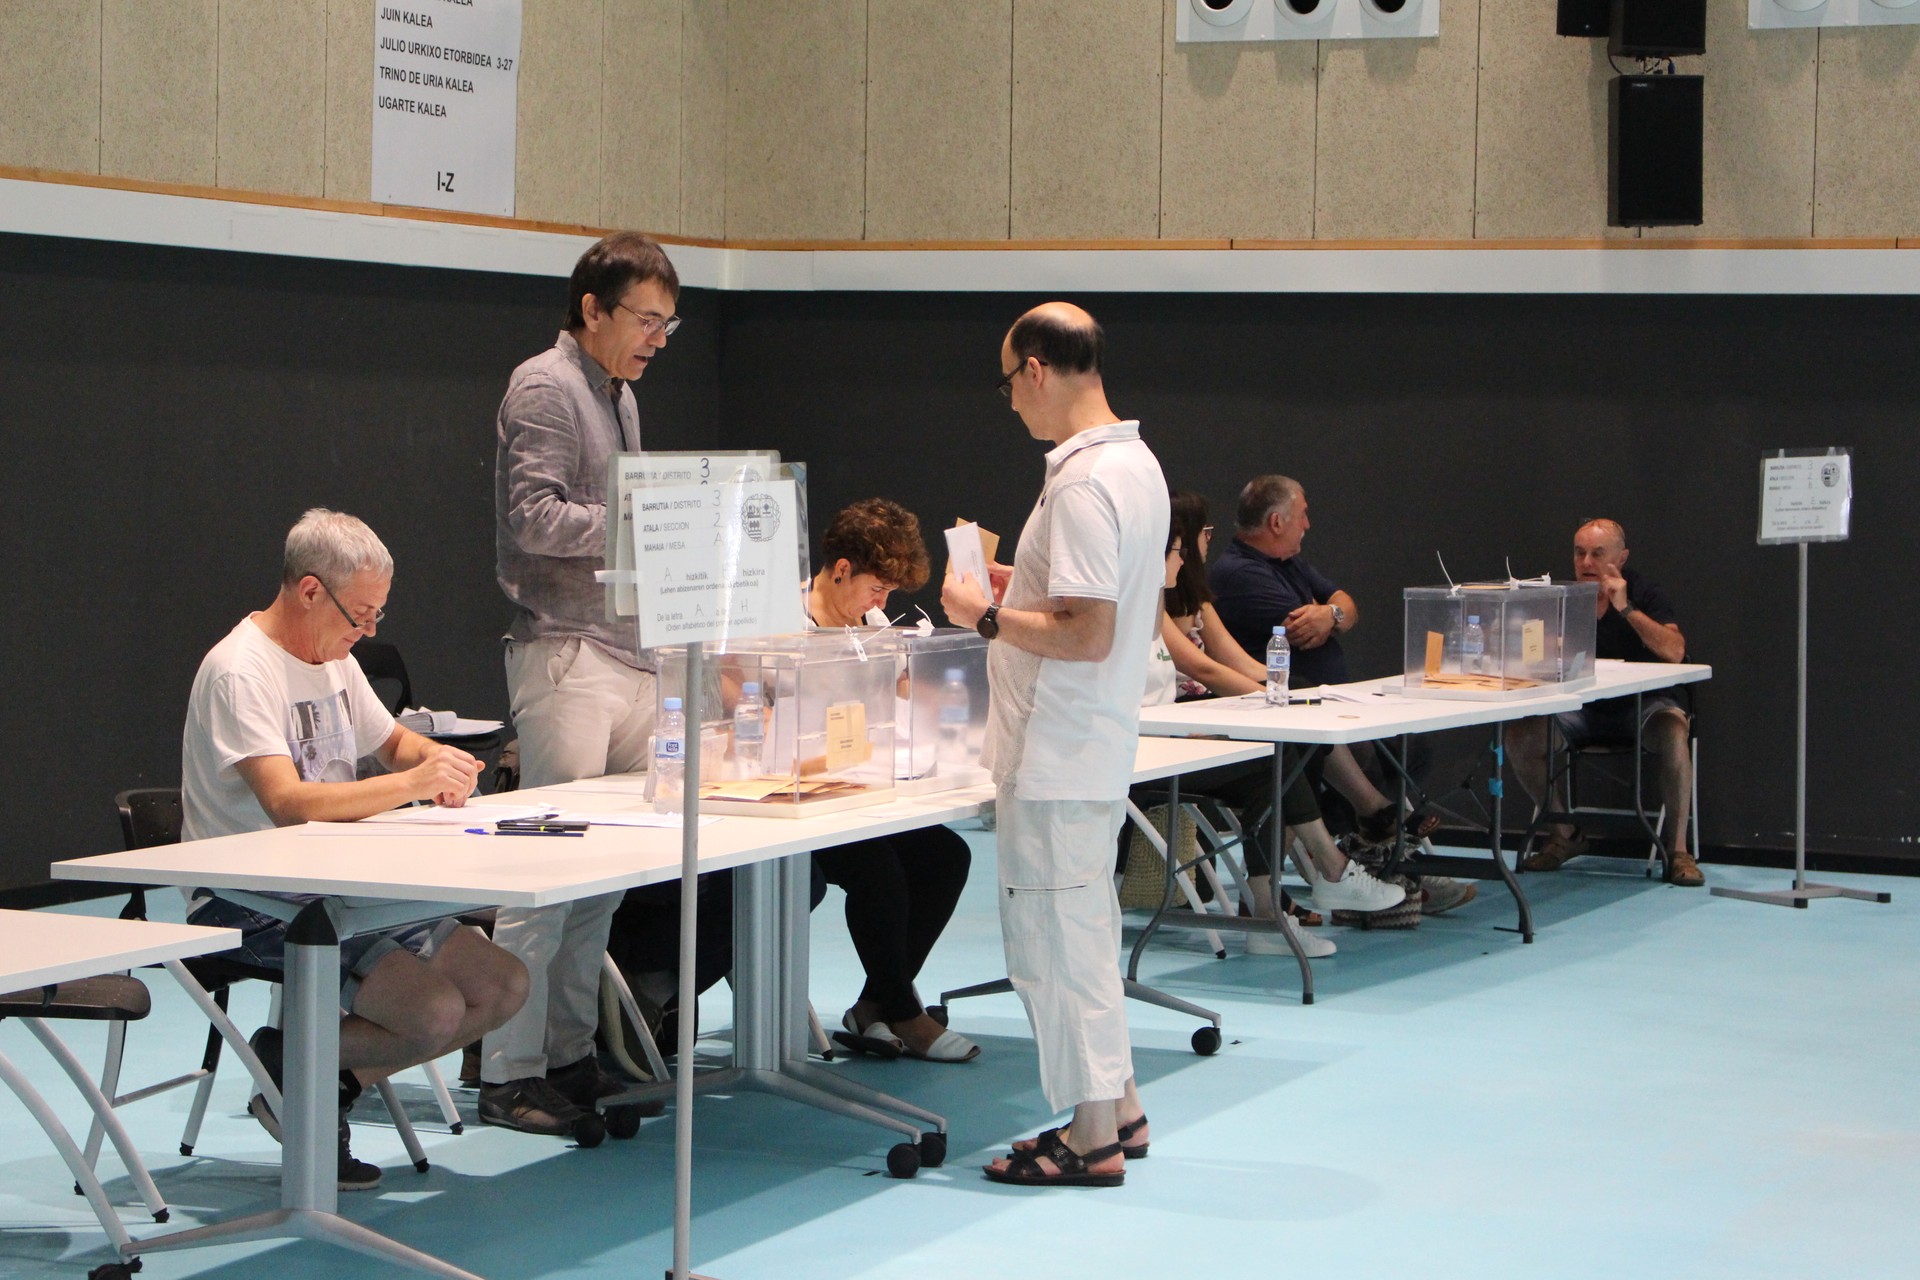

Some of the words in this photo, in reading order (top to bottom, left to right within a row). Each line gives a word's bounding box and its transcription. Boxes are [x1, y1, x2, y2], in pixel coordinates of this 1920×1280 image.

[381, 7, 400, 22] JUIN
[403, 11, 433, 28] KALEA
[380, 37, 406, 52] JULIO
[408, 41, 441, 59] URKIXO
[444, 48, 492, 68] ETORBIDEA
[496, 57, 513, 71] 3-27
[380, 66, 406, 82] TRINO
[409, 71, 421, 85] DE
[423, 73, 444, 88] URIA
[445, 77, 474, 93] KALEA
[379, 96, 415, 113] UGARTE
[417, 102, 447, 118] KALEA
[437, 171, 455, 192] I-Z
[625, 471, 658, 480] BARRA
[700, 457, 710, 478] 3
[642, 502, 669, 511] BARRUTIA
[674, 500, 702, 510] DISTRITO
[712, 489, 721, 507] 3
[643, 523, 659, 532] ATALA
[663, 522, 690, 532] SECCION
[713, 512, 724, 527] 2
[644, 543, 664, 552] MAHAIA
[669, 541, 686, 550] MESA
